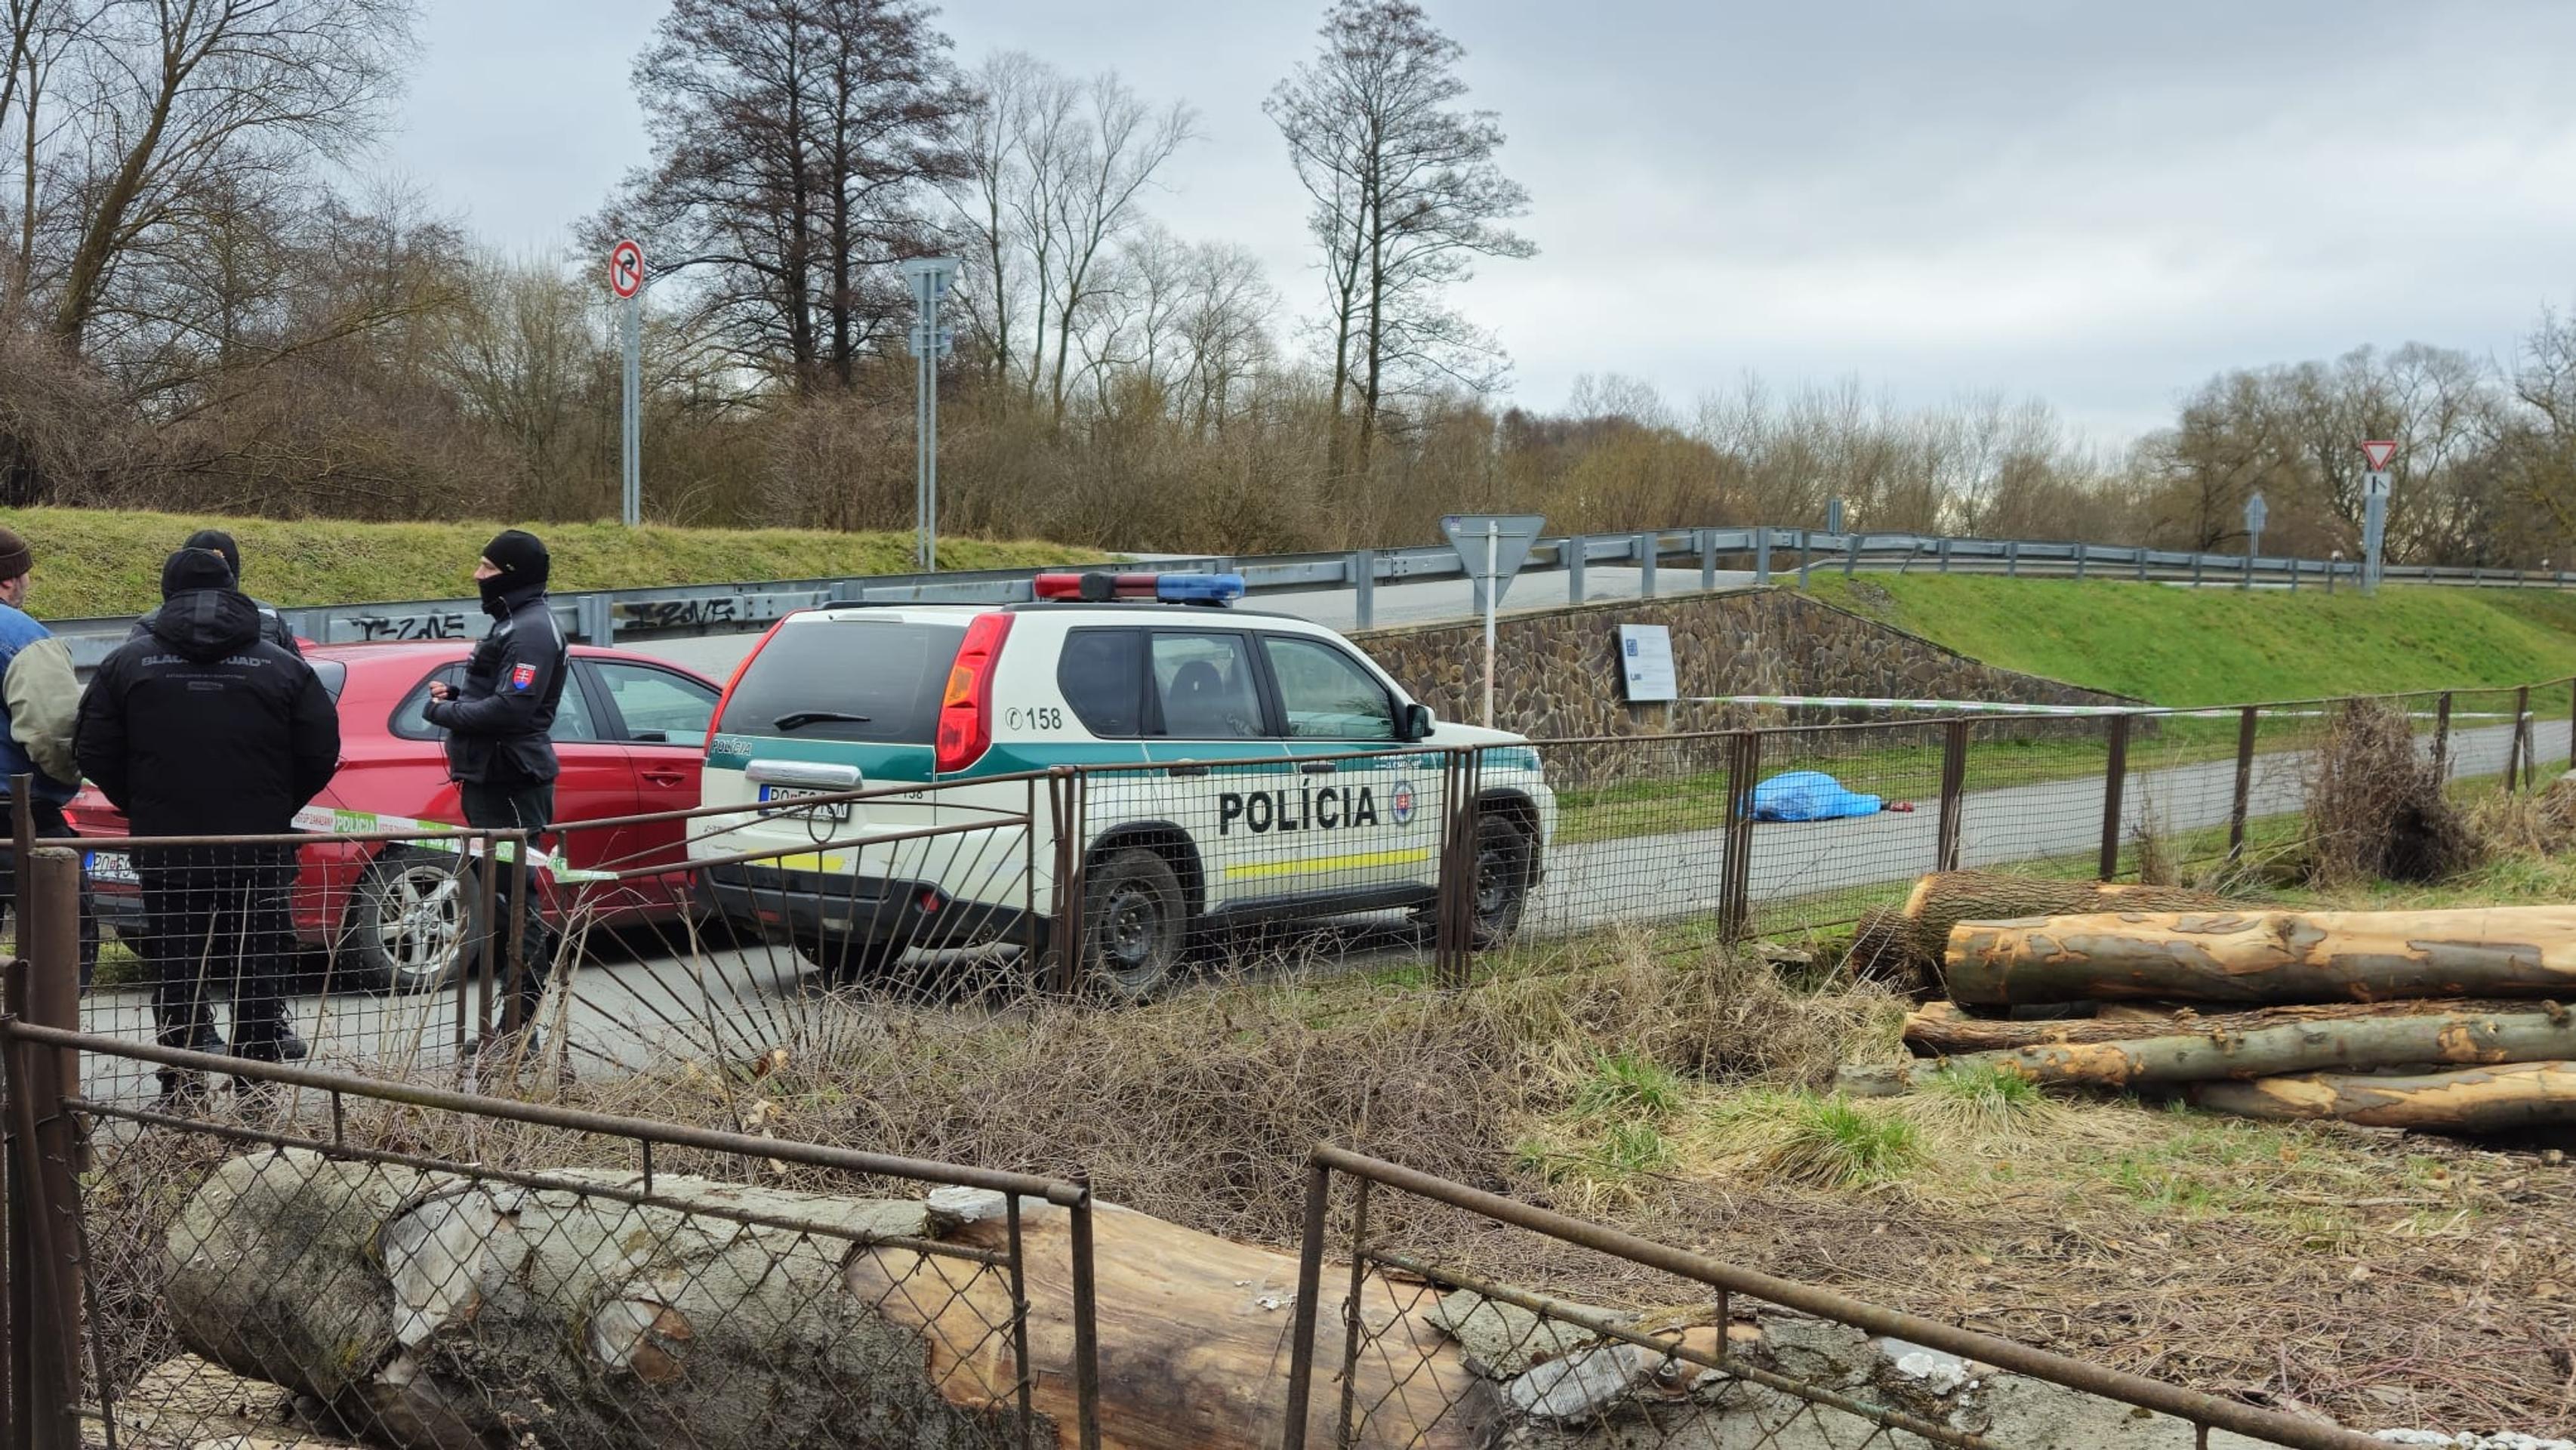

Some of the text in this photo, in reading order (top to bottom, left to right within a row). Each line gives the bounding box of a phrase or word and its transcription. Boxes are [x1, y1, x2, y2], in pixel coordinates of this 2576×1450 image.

[142, 654, 189, 666] BLAC
[1027, 707, 1062, 730] 158
[1220, 778, 1378, 835] POLÍCIA
[336, 813, 375, 833] POLÍCIA
